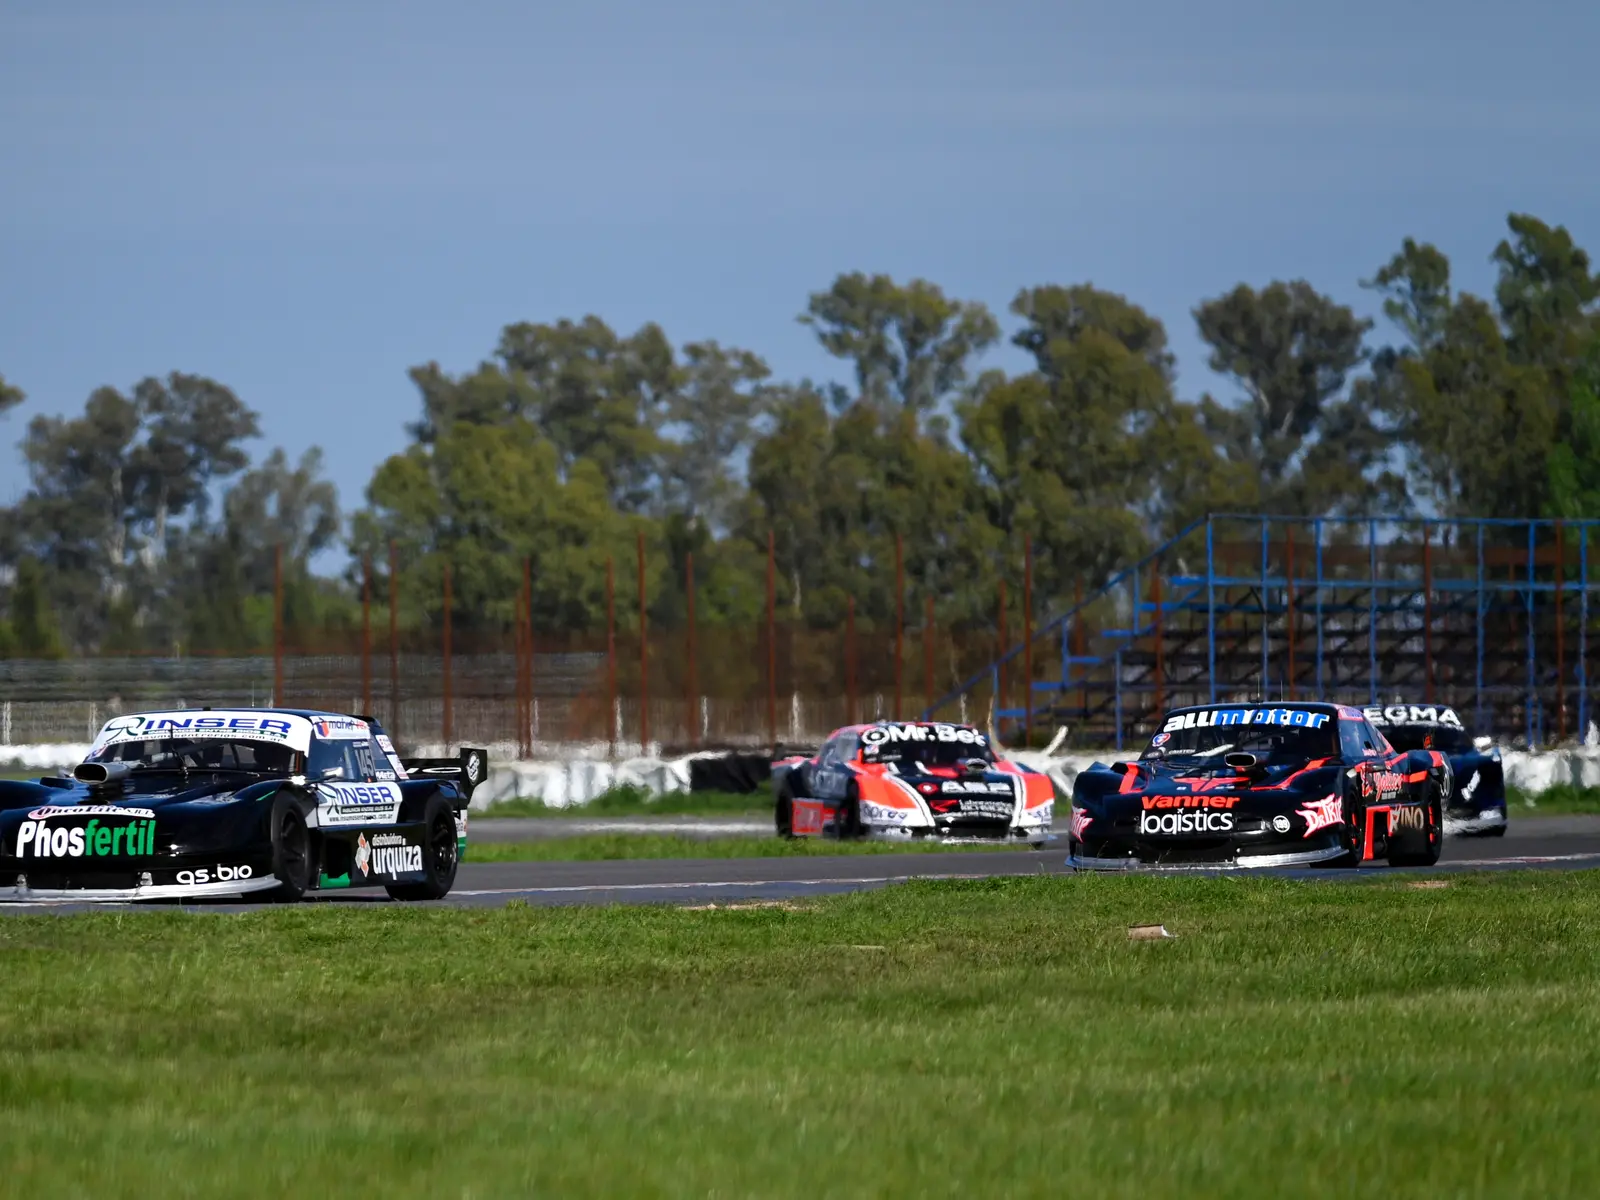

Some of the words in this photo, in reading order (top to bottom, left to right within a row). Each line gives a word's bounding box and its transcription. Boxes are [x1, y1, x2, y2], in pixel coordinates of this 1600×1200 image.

[16, 819, 157, 858] Phosfertil
[1140, 807, 1234, 835] logistics
[372, 838, 423, 881] urquiza
